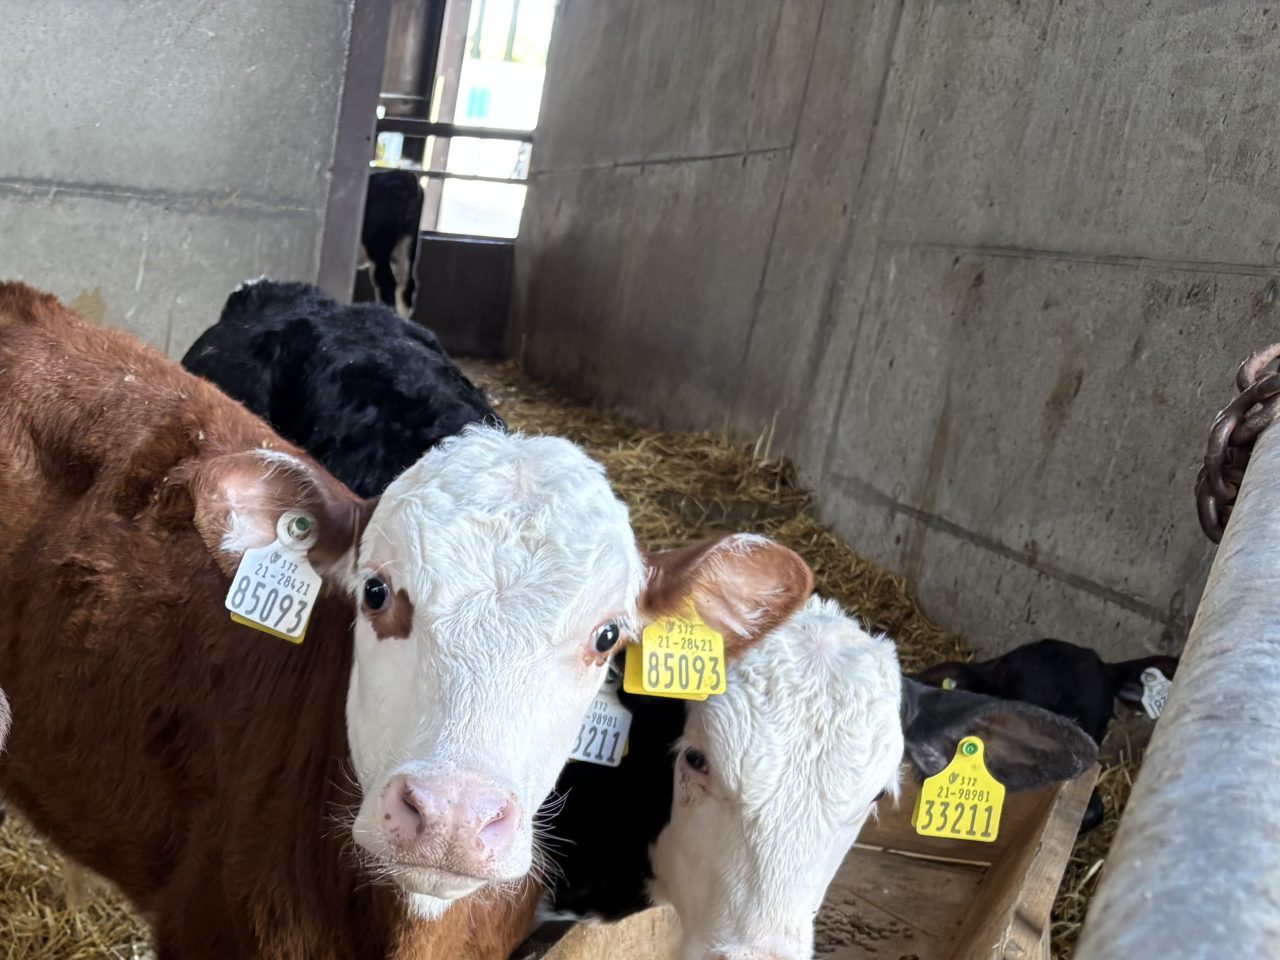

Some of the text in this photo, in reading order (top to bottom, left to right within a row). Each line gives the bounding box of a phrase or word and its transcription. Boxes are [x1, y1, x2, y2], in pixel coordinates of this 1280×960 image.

[254, 563, 311, 596] 21-28421
[231, 575, 308, 634] 85093
[658, 635, 713, 652] 21-28421
[647, 652, 721, 691] 85093
[937, 786, 990, 803] 21-98981
[921, 799, 993, 838] 33211
